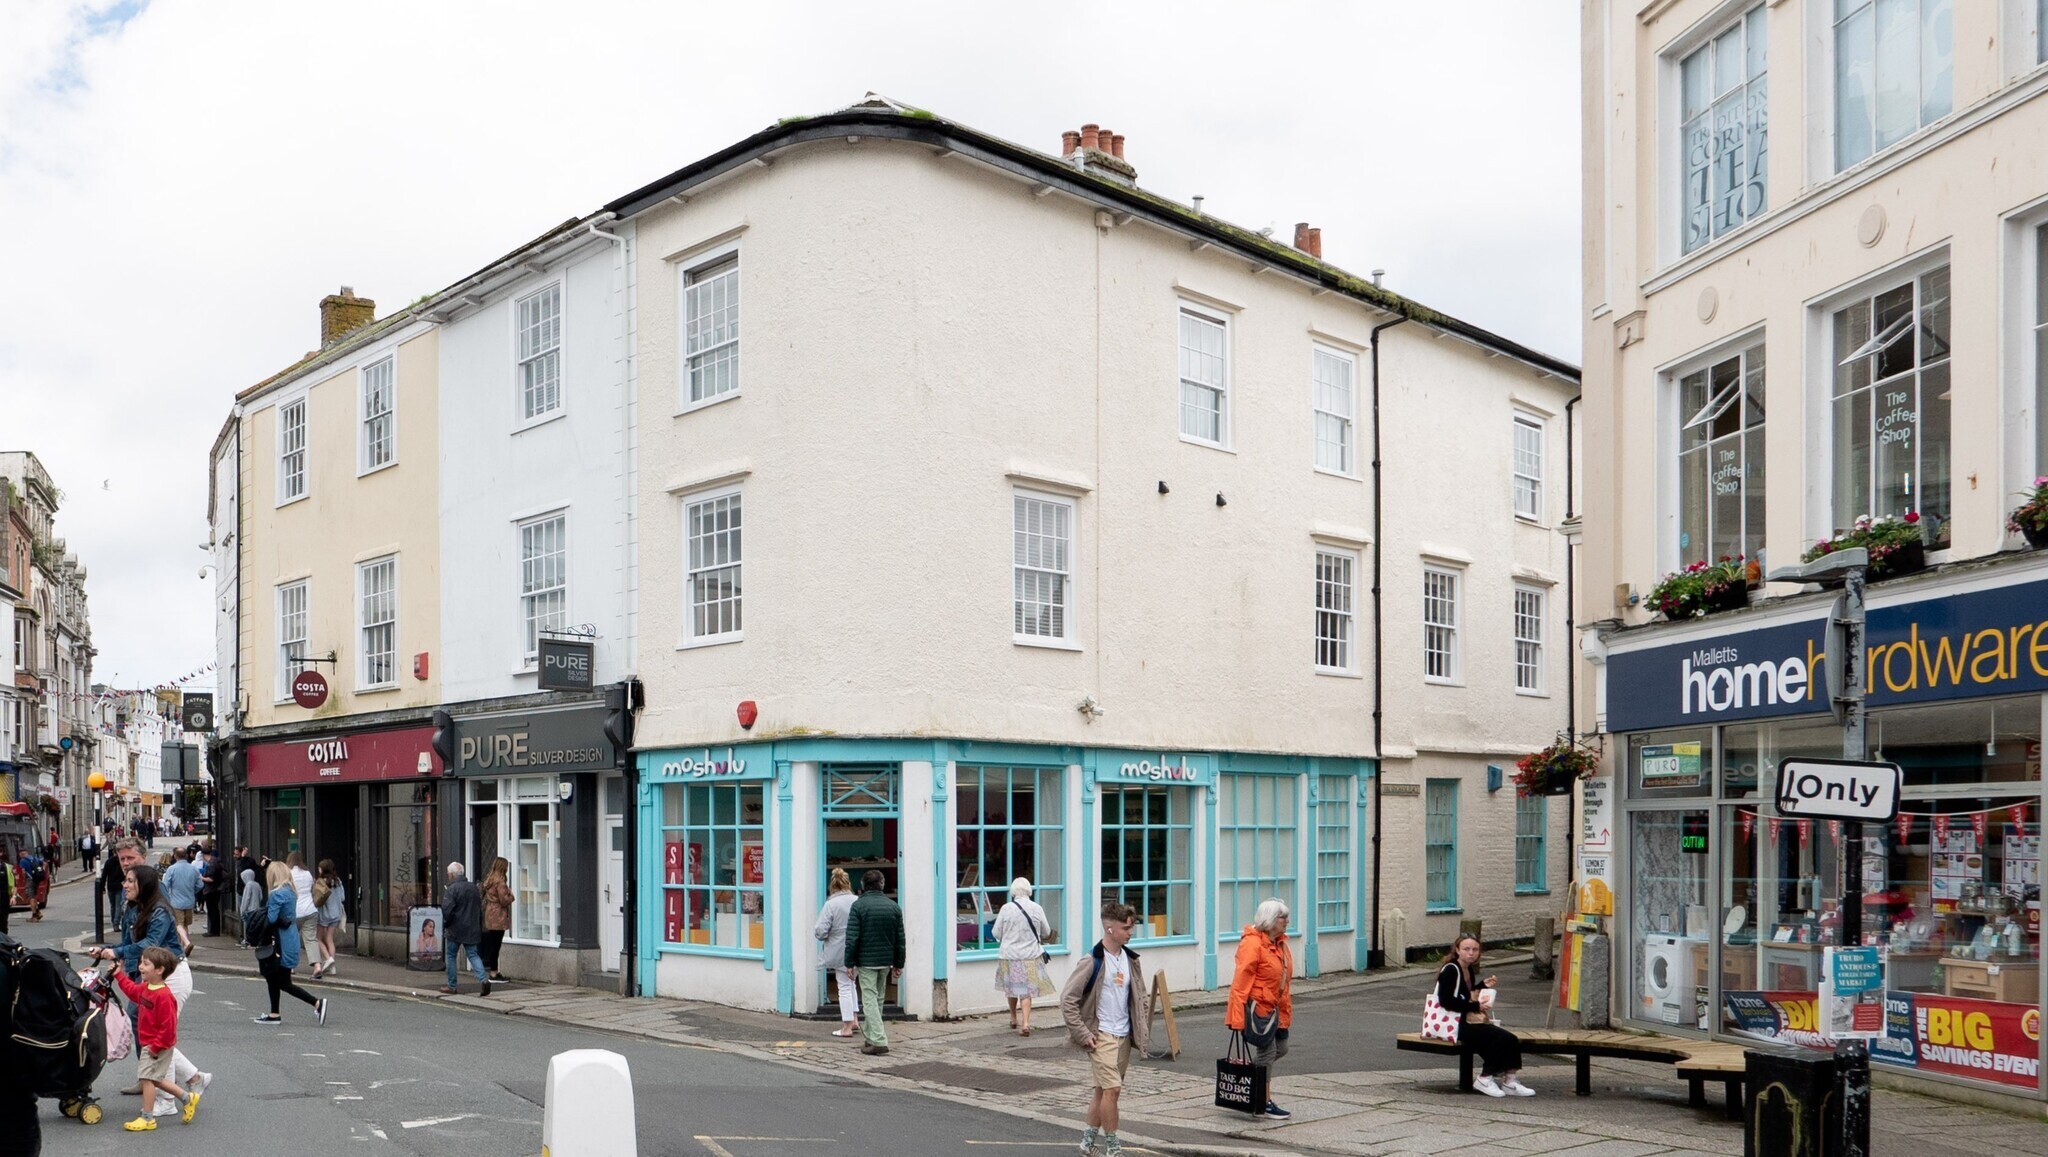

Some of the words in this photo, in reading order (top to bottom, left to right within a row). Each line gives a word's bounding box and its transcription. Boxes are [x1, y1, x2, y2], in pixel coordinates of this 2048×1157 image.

[1885, 392, 1907, 407] The
[1876, 407, 1917, 432] Coffee
[1881, 427, 1911, 445] Shop
[1720, 450, 1735, 463] The
[1712, 464, 1743, 484] Coffee
[1716, 481, 1738, 496] Shop
[545, 653, 588, 670] PURE
[1692, 646, 1738, 668] Malletts
[296, 683, 325, 692] COSTA
[308, 741, 348, 763] COSTA
[460, 732, 530, 769] PURE
[530, 750, 565, 766] SILVER
[566, 747, 603, 763] DESIGN
[662, 747, 746, 778] moshulu
[1120, 754, 1197, 780] moshulu
[1646, 758, 1677, 773] PURO
[319, 767, 341, 776] COFFEE
[1796, 774, 1880, 808] Only
[2015, 807, 2023, 828] SALE
[1585, 867, 1605, 876] MARKET
[1838, 954, 1864, 962] TRURO
[1838, 963, 1871, 971] ANTIQUES
[1730, 995, 1766, 1008] home
[1916, 1007, 1927, 1042] THE
[1928, 1007, 1995, 1051] BIG
[1921, 1043, 1992, 1070] SAVINGS
[1220, 1072, 1237, 1083] TAKE
[1238, 1076, 1252, 1085] AN
[1219, 1081, 1234, 1092] OLD
[1233, 1084, 1250, 1095] BAG
[1219, 1090, 1250, 1104] SHOPPING
